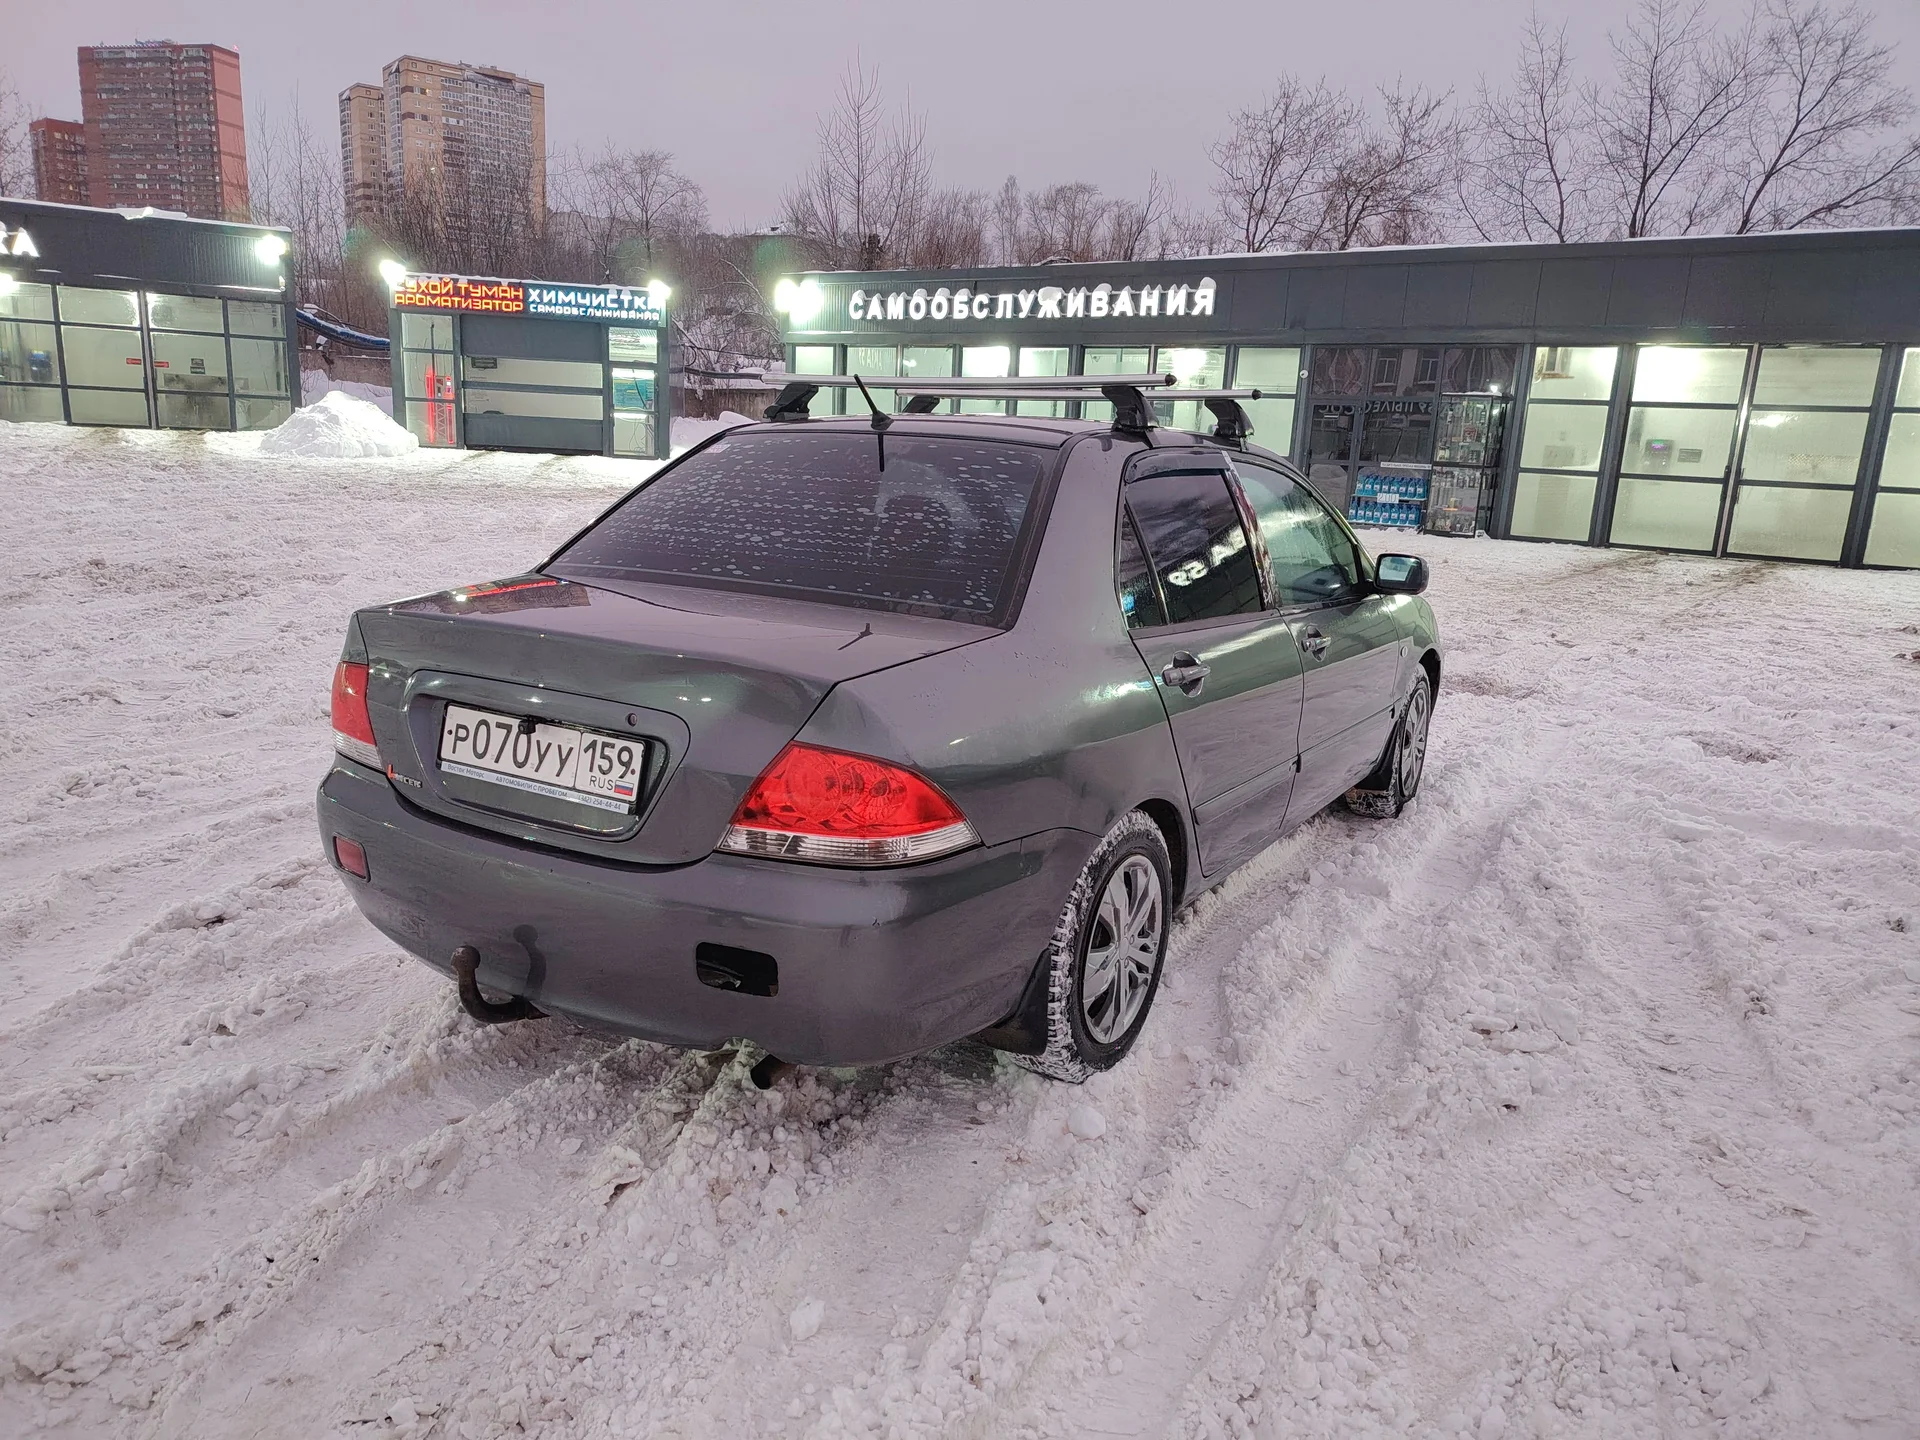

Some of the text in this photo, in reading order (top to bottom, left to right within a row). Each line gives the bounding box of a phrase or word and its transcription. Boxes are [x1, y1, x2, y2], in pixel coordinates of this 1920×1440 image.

[457, 282, 523, 299] ТУМАН
[528, 287, 660, 311] ХИМЧИСТКА
[394, 294, 523, 311] АРОМАТИЗАТОР
[529, 304, 660, 321] САМООБСЛУЖИВАНИЯ
[849, 287, 1216, 320] САМООБСЛУЖИВАНИЯ
[583, 738, 634, 779] 159
[447, 763, 466, 773] Восток
[466, 768, 485, 778] Моторс
[496, 776, 533, 789] АВТОМОБИЛИ
[589, 775, 613, 791] RUS
